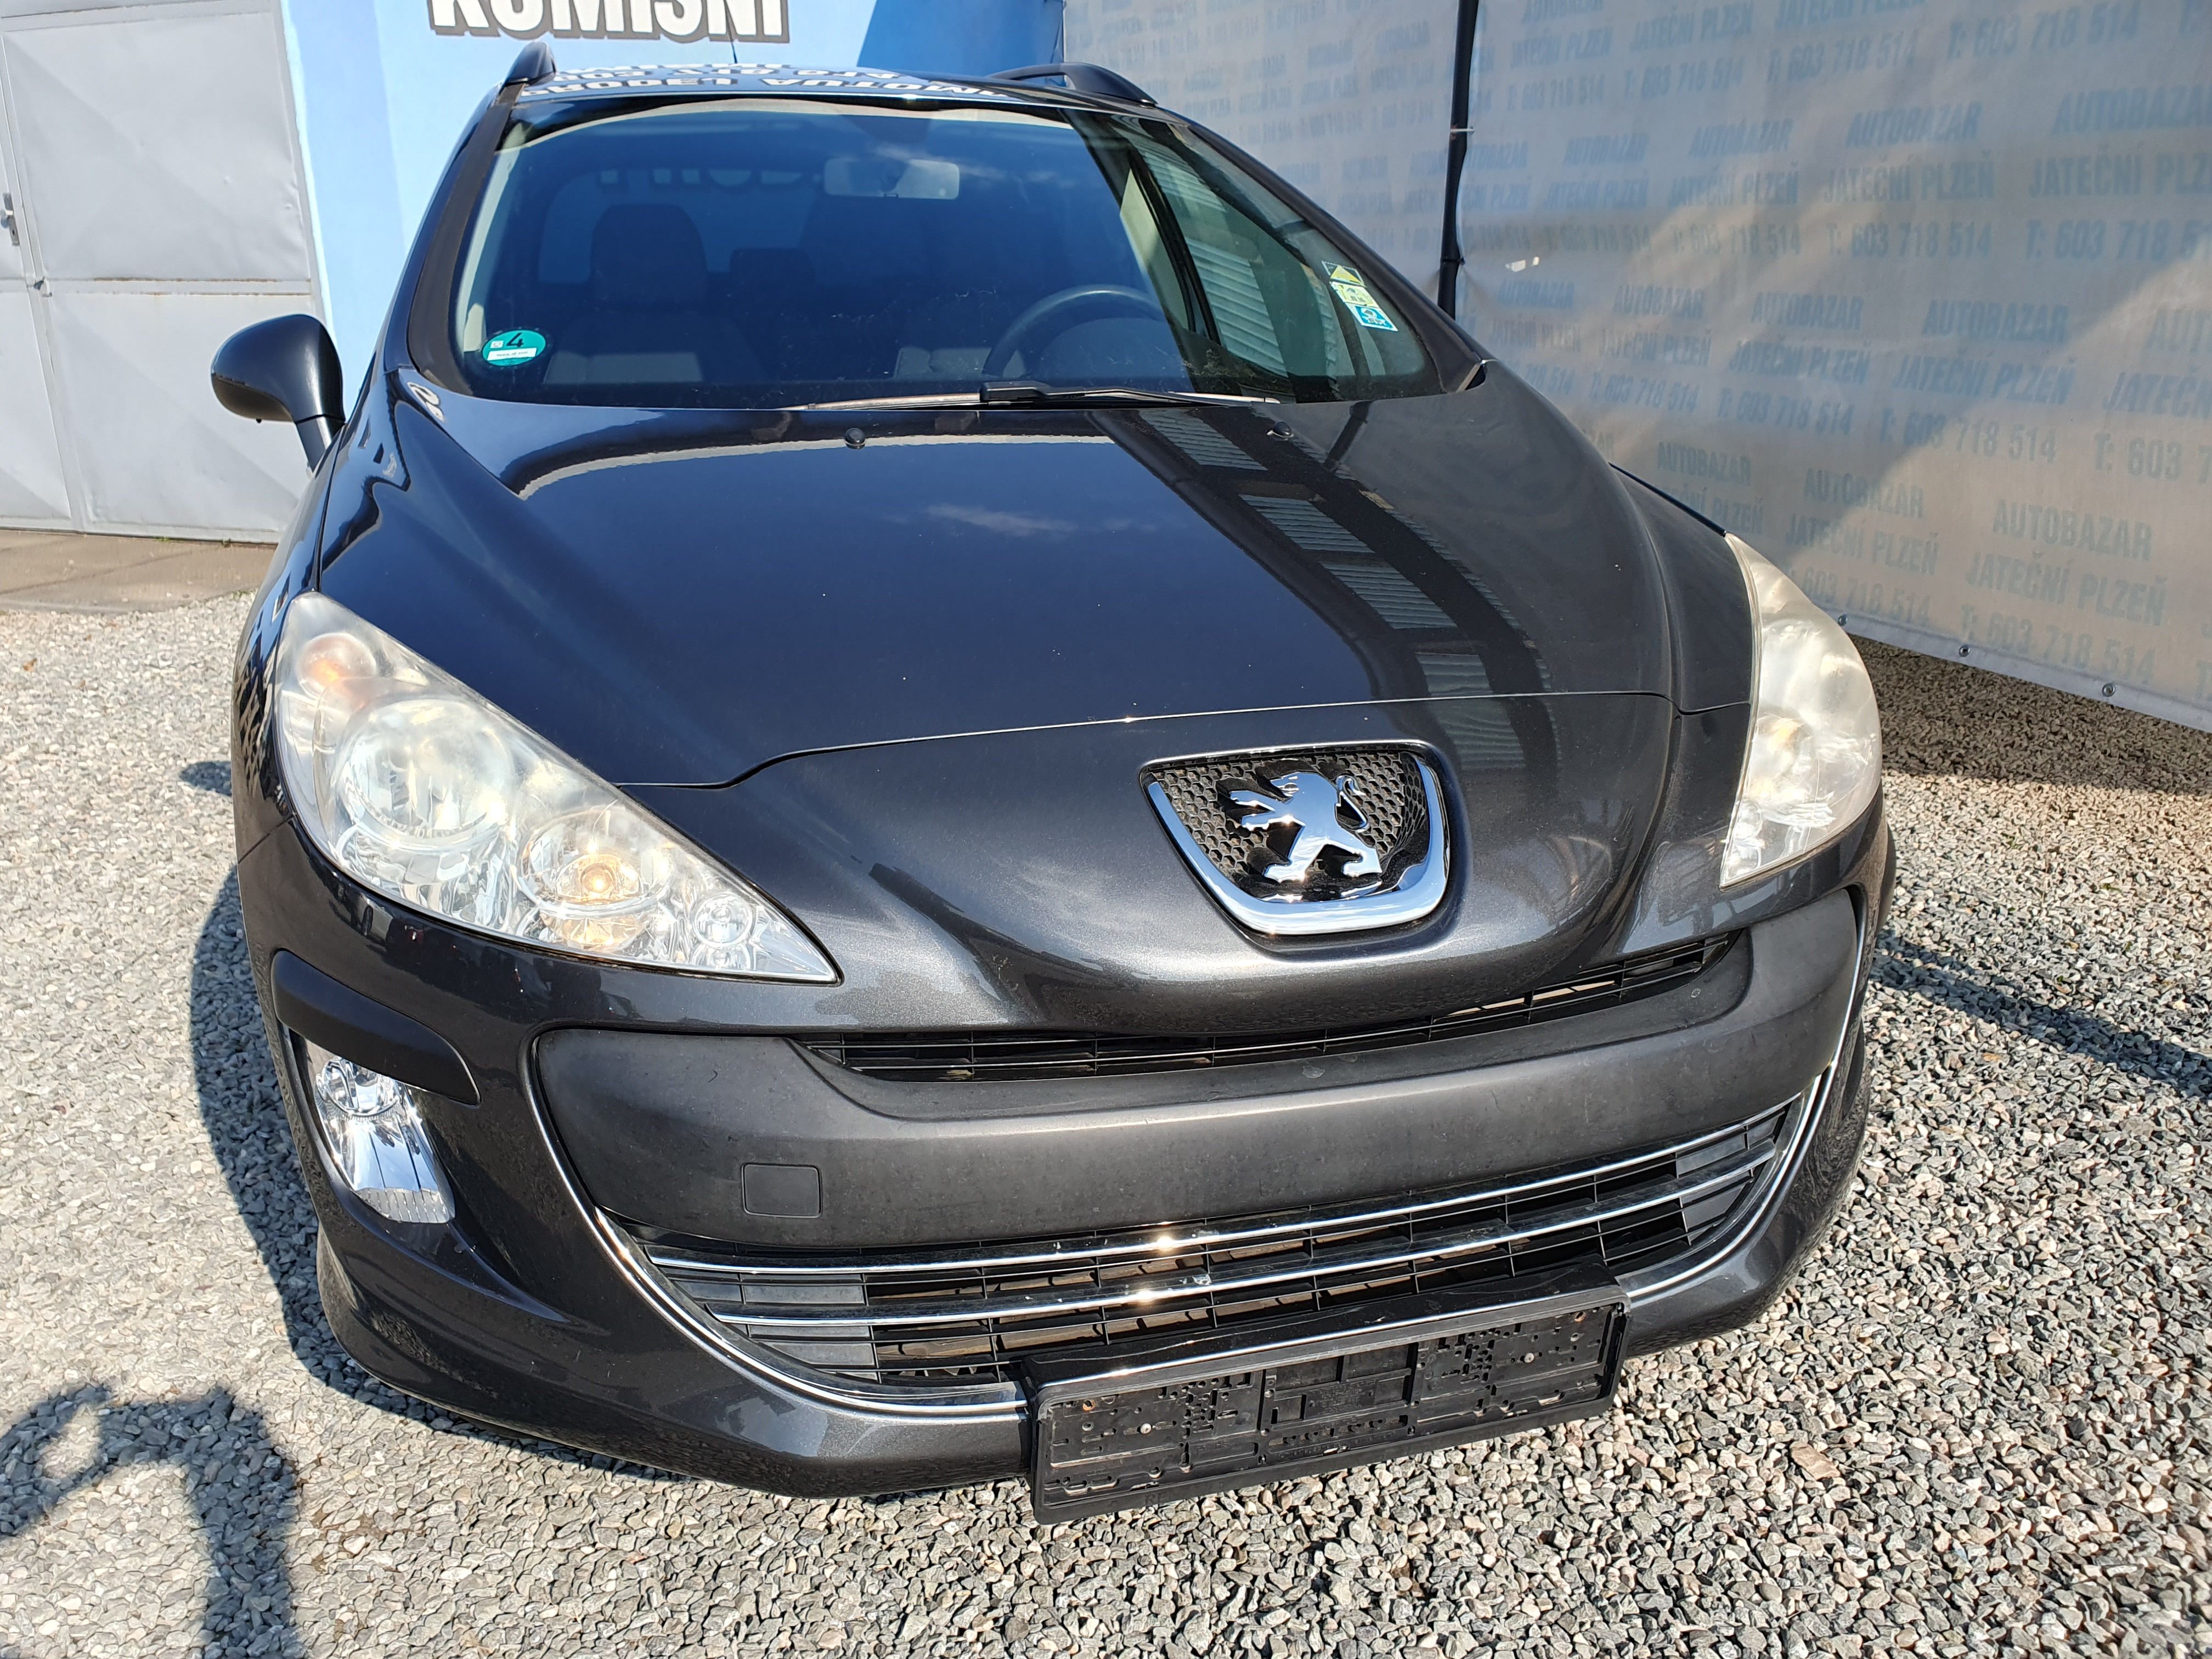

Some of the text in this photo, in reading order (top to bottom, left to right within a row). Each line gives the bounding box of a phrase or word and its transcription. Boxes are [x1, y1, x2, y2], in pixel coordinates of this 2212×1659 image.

[1975, 15, 2021, 57] 603
[2032, 7, 2081, 51] 718
[2086, 1, 2140, 46] 514
[1678, 61, 1708, 92] 718
[1712, 56, 1745, 90] 514
[1787, 42, 1825, 82] 603
[1832, 35, 1871, 74] 718
[1689, 120, 1794, 157] AUTOBAZAR
[1845, 101, 1982, 149] AUTOBAZAR
[1564, 133, 1651, 166] AUTOBAZAR
[2029, 141, 2144, 198] JATEČNÍ
[1743, 160, 1799, 205] PLZEŇ
[1824, 149, 1995, 202] JATEČNÍ PLZEŇ
[1767, 223, 1801, 257] 514
[1850, 222, 1889, 258] 603
[1899, 222, 1940, 258] 718
[1948, 222, 1991, 258] 514
[2027, 220, 2046, 259] T:
[2055, 220, 2107, 260] 603
[2117, 220, 2170, 262] 718
[1613, 285, 1706, 318] AUTOBAZAR
[1751, 291, 1864, 330] AUTOBAZAR
[1921, 298, 2069, 343] AUTOBAZAR
[505, 332, 524, 348] 4
[1663, 328, 1712, 366] PLZEŇ
[1729, 335, 1871, 384] JATEČNÍ PLZEŇ
[1635, 377, 1668, 408] 718
[1668, 382, 1701, 413] 514
[1892, 350, 2076, 405] JATEČNÍ PLZEŇ
[1735, 390, 1771, 422] 603
[1775, 394, 1812, 430] 718
[1815, 401, 1855, 436] 514
[1880, 408, 2057, 464] T: 603 718 514
[2094, 432, 2115, 474] T:
[2128, 437, 2182, 482] 603
[1657, 442, 1751, 486] AUTOBAZAR
[1803, 468, 1924, 518] AUTOBAZAR
[1993, 499, 2153, 561] AUTOBAZAR
[1871, 532, 1942, 575] PLZEŇ
[1847, 578, 1884, 615] 718
[1891, 589, 1931, 627] 514
[1965, 551, 2075, 606] JATEČNÍ
[2077, 574, 2168, 627] PLZEŇ
[1960, 605, 2156, 685] T: 603 718 514
